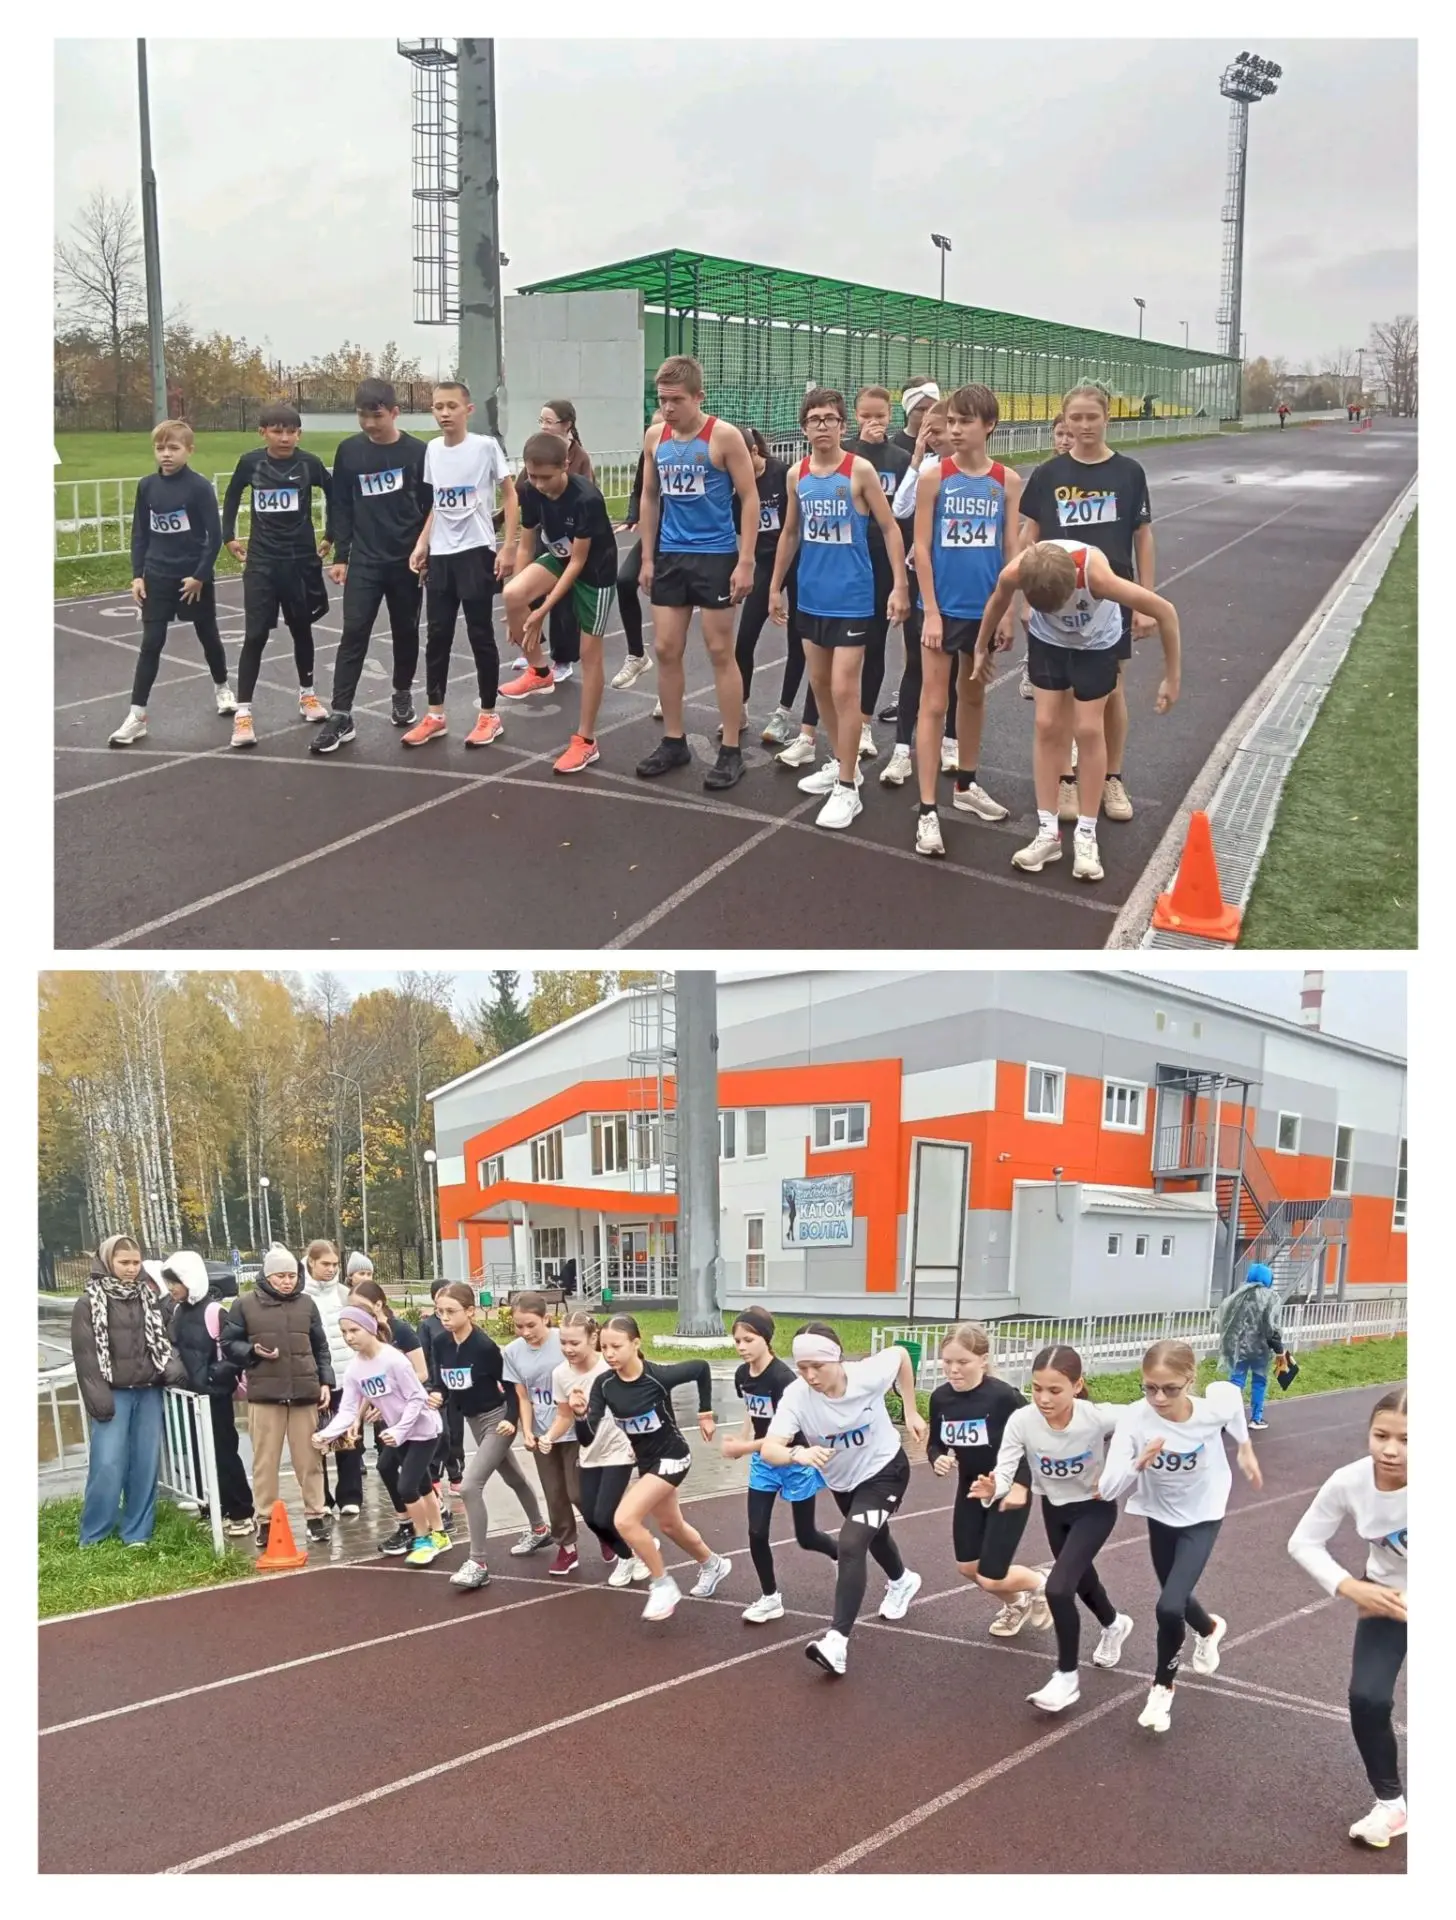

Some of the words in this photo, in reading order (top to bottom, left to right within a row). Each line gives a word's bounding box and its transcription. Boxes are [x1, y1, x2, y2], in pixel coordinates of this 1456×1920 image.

[364, 473, 396, 493] 119
[663, 472, 697, 493] 142
[258, 491, 291, 510] 840
[438, 488, 467, 508] 281
[944, 496, 999, 518] RUSSIA
[1065, 499, 1105, 523] 207
[152, 513, 181, 532] 366
[808, 518, 841, 541] 941
[946, 519, 988, 544] 434
[800, 1201, 845, 1219] КАТОК
[800, 1220, 848, 1240] ВОЛГА
[361, 1378, 386, 1397] 109
[442, 1369, 465, 1389] 169
[825, 1430, 865, 1448] 710
[945, 1421, 979, 1443] 945
[1040, 1456, 1084, 1477] 885
